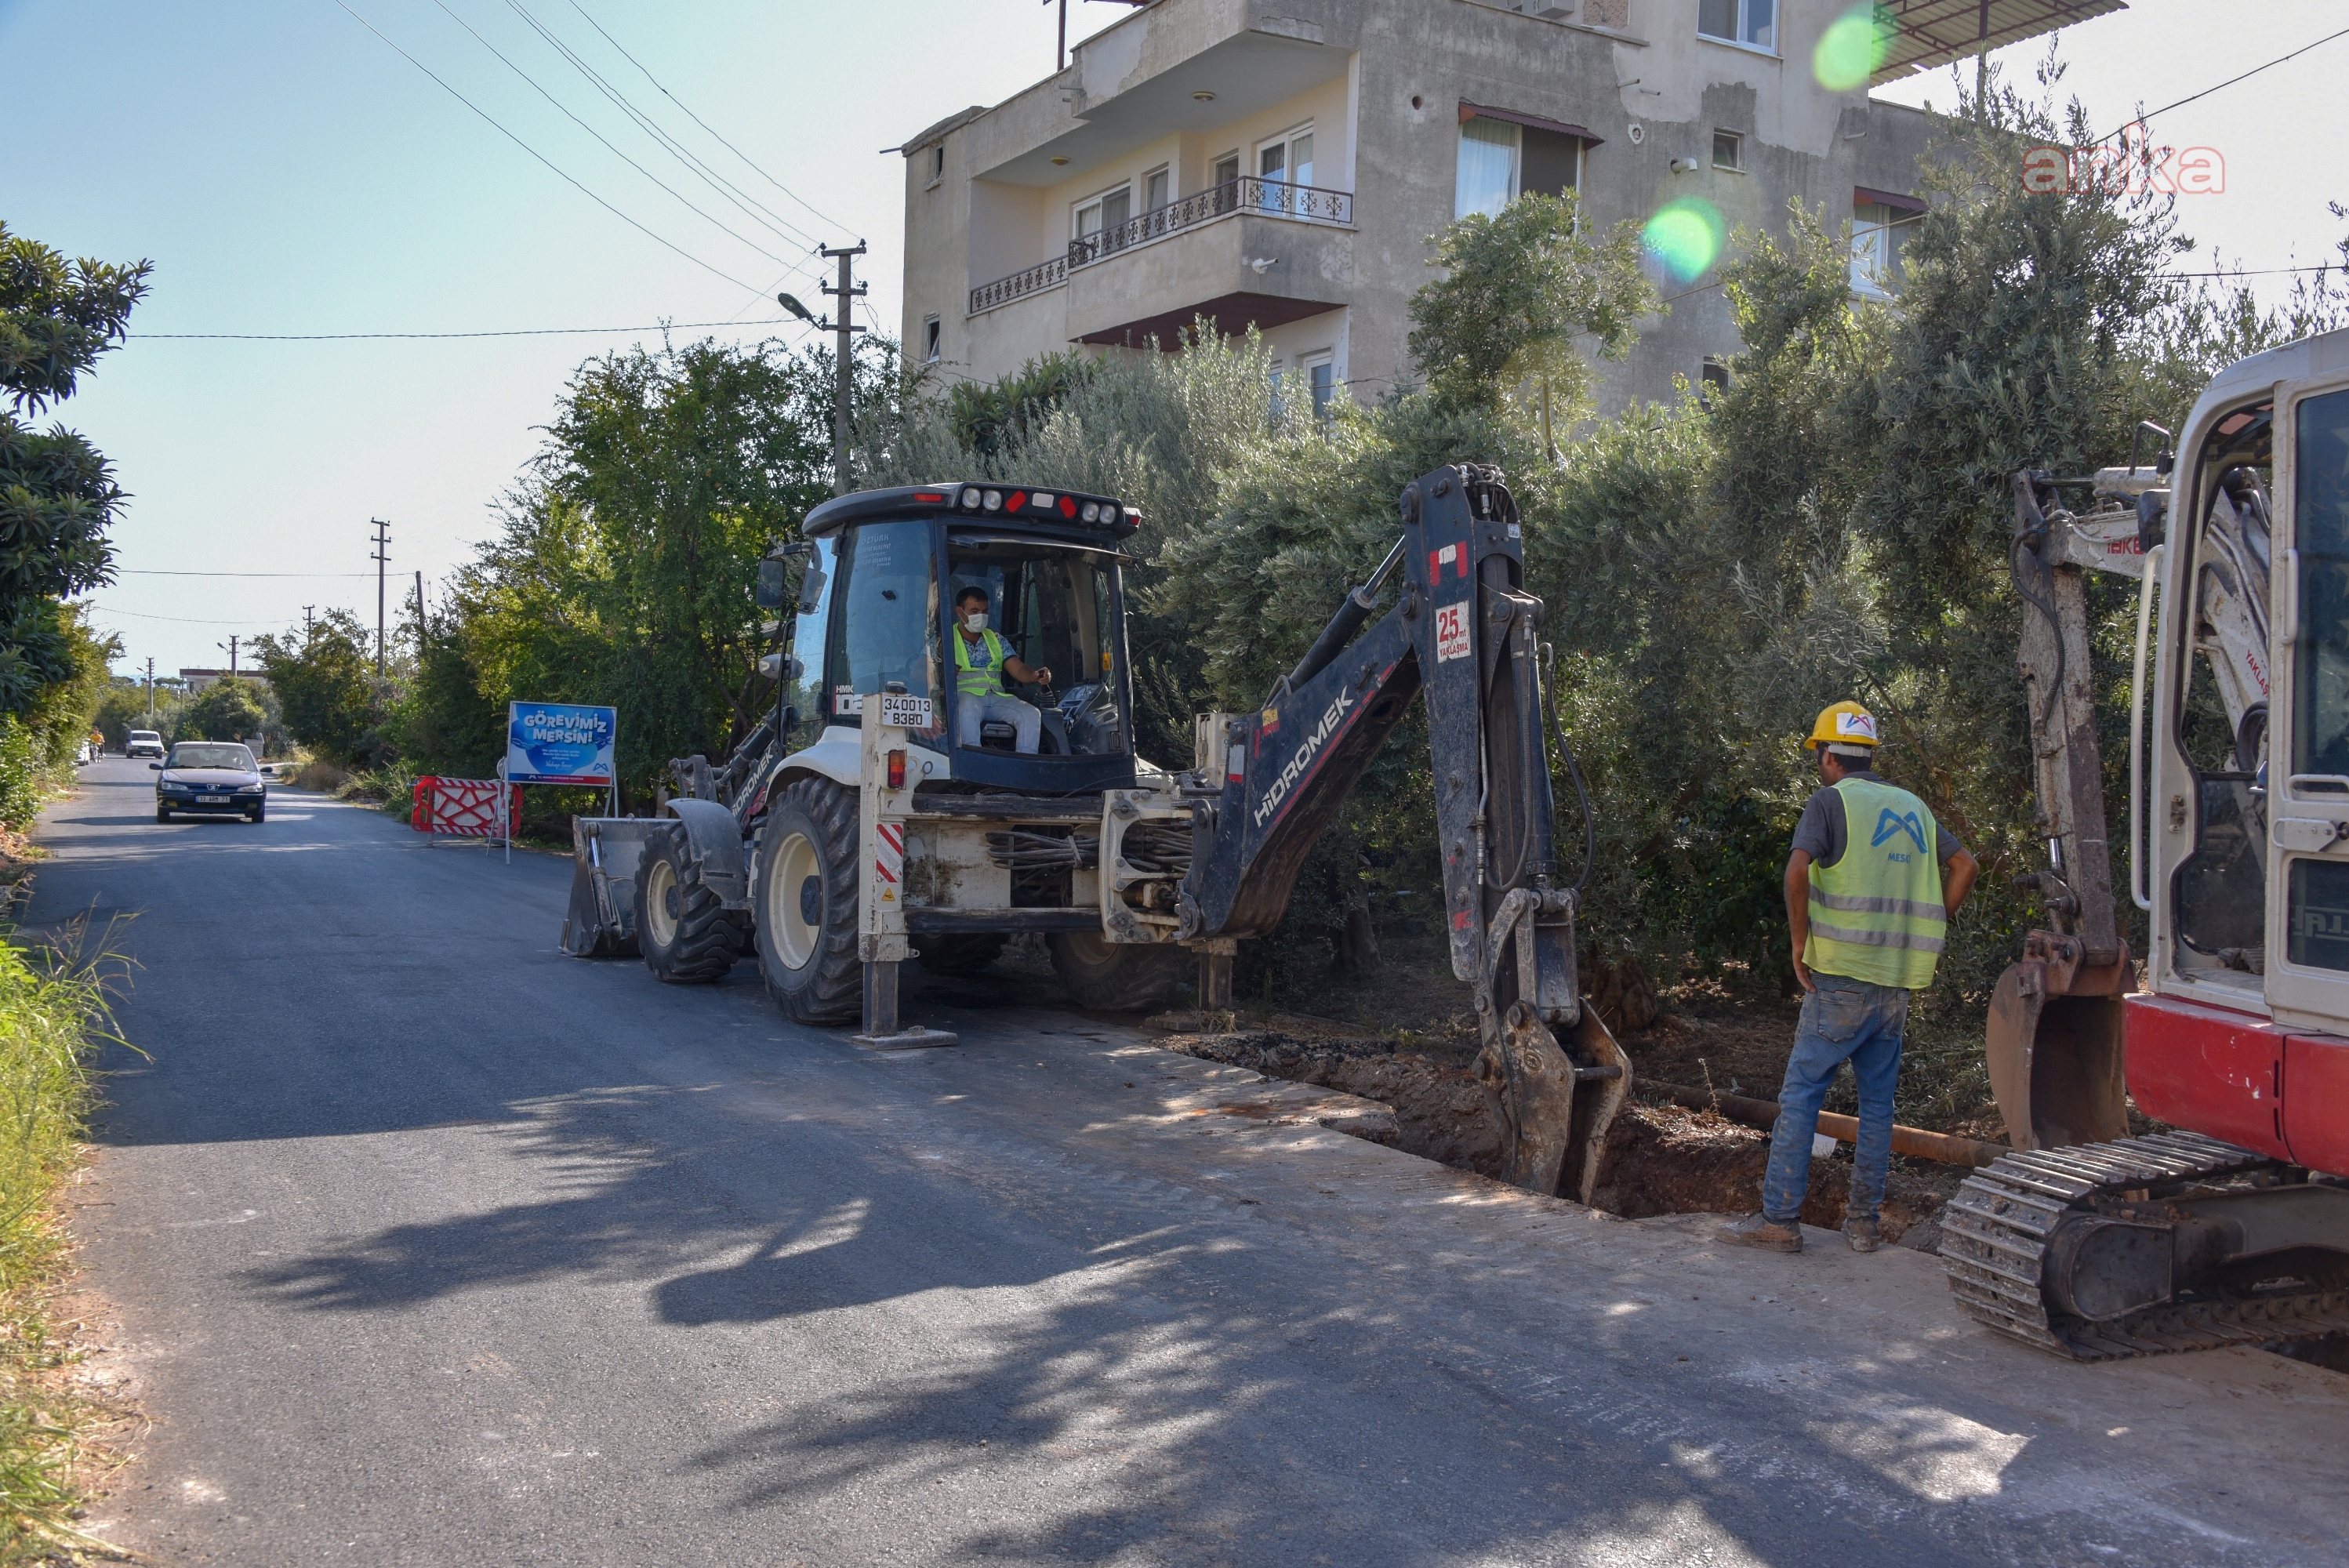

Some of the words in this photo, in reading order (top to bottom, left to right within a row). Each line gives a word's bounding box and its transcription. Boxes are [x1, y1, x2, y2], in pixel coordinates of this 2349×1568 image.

[861, 533, 890, 545] ÖZTÜRK
[1439, 608, 1459, 642] 25
[1459, 628, 1466, 637] mt
[1440, 642, 1469, 658] YAKLAŞMA
[2246, 648, 2270, 698] YAKLAŞ
[836, 684, 855, 694] HMK
[884, 698, 931, 712] 340013
[524, 710, 607, 733] GÖREVİMİZ
[892, 712, 923, 725] 8380
[533, 728, 593, 744] MERSİN!
[1254, 684, 1354, 828] HİDROMEK
